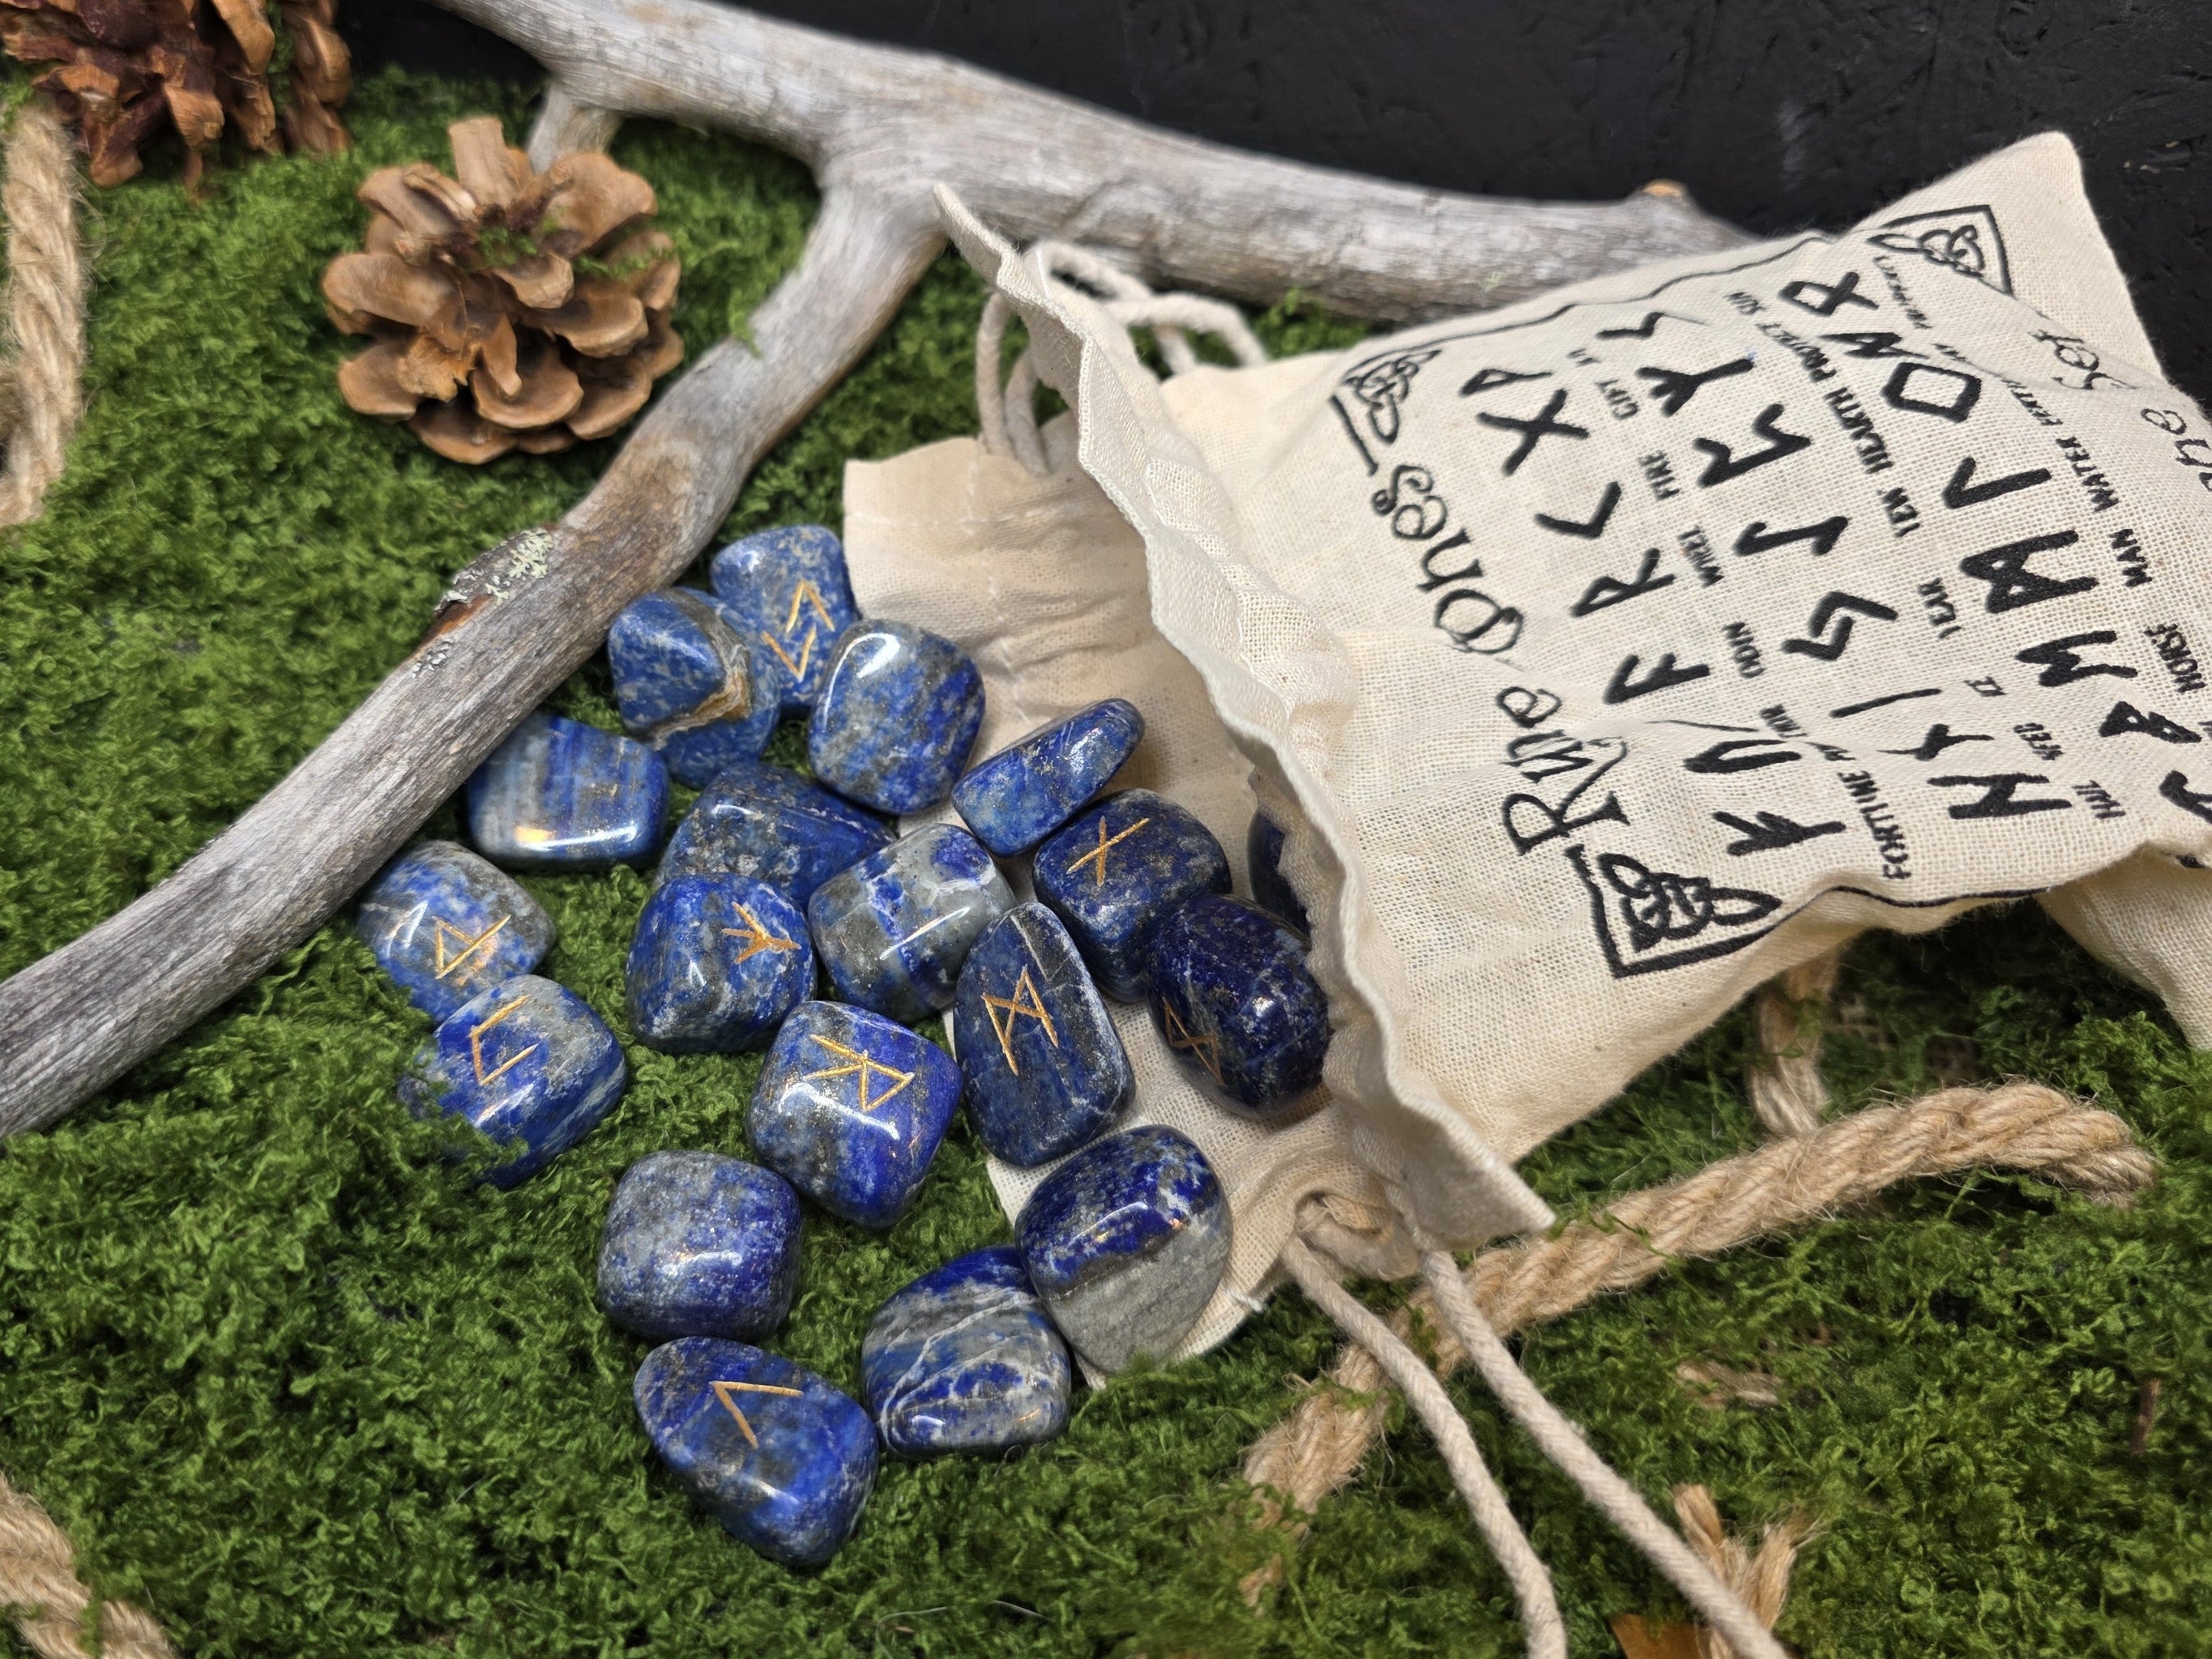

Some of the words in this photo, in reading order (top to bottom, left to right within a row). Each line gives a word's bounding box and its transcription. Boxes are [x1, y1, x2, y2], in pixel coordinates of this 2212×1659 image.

[1595, 379, 1639, 420] GIFT
[1825, 388, 1894, 475] HEARTH
[1638, 450, 1680, 500] FIRE
[2056, 436, 2119, 512] WATER
[1878, 487, 1922, 536] YEW
[1676, 525, 1724, 587] WHEEL
[2109, 527, 2154, 587] MAN
[1917, 578, 1962, 639] YEAR
[1723, 622, 1766, 679] ODIN
[2144, 623, 2206, 693] HORSE
